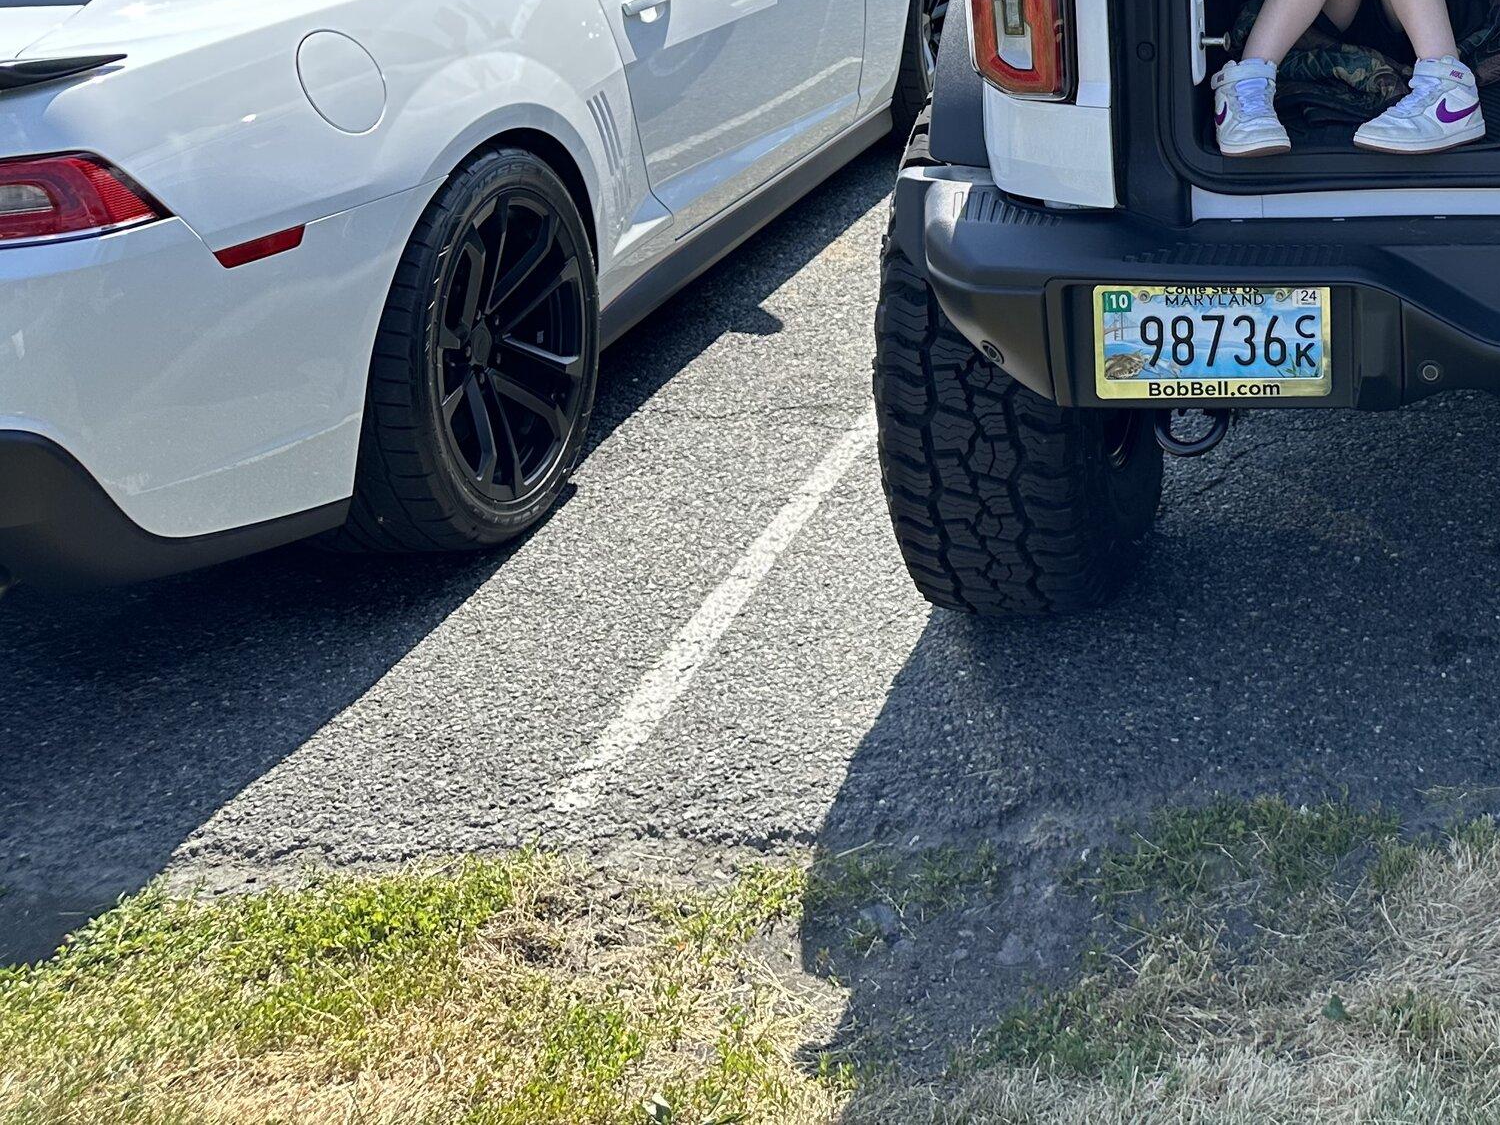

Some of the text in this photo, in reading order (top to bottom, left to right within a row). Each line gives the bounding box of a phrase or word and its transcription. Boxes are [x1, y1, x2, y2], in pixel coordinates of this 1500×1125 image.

[1110, 294, 1129, 310] 10
[1165, 294, 1265, 306] MARYLAND
[1300, 289, 1318, 302] 24
[1139, 315, 1288, 368] 98736
[1148, 381, 1281, 398] BobBell.com
